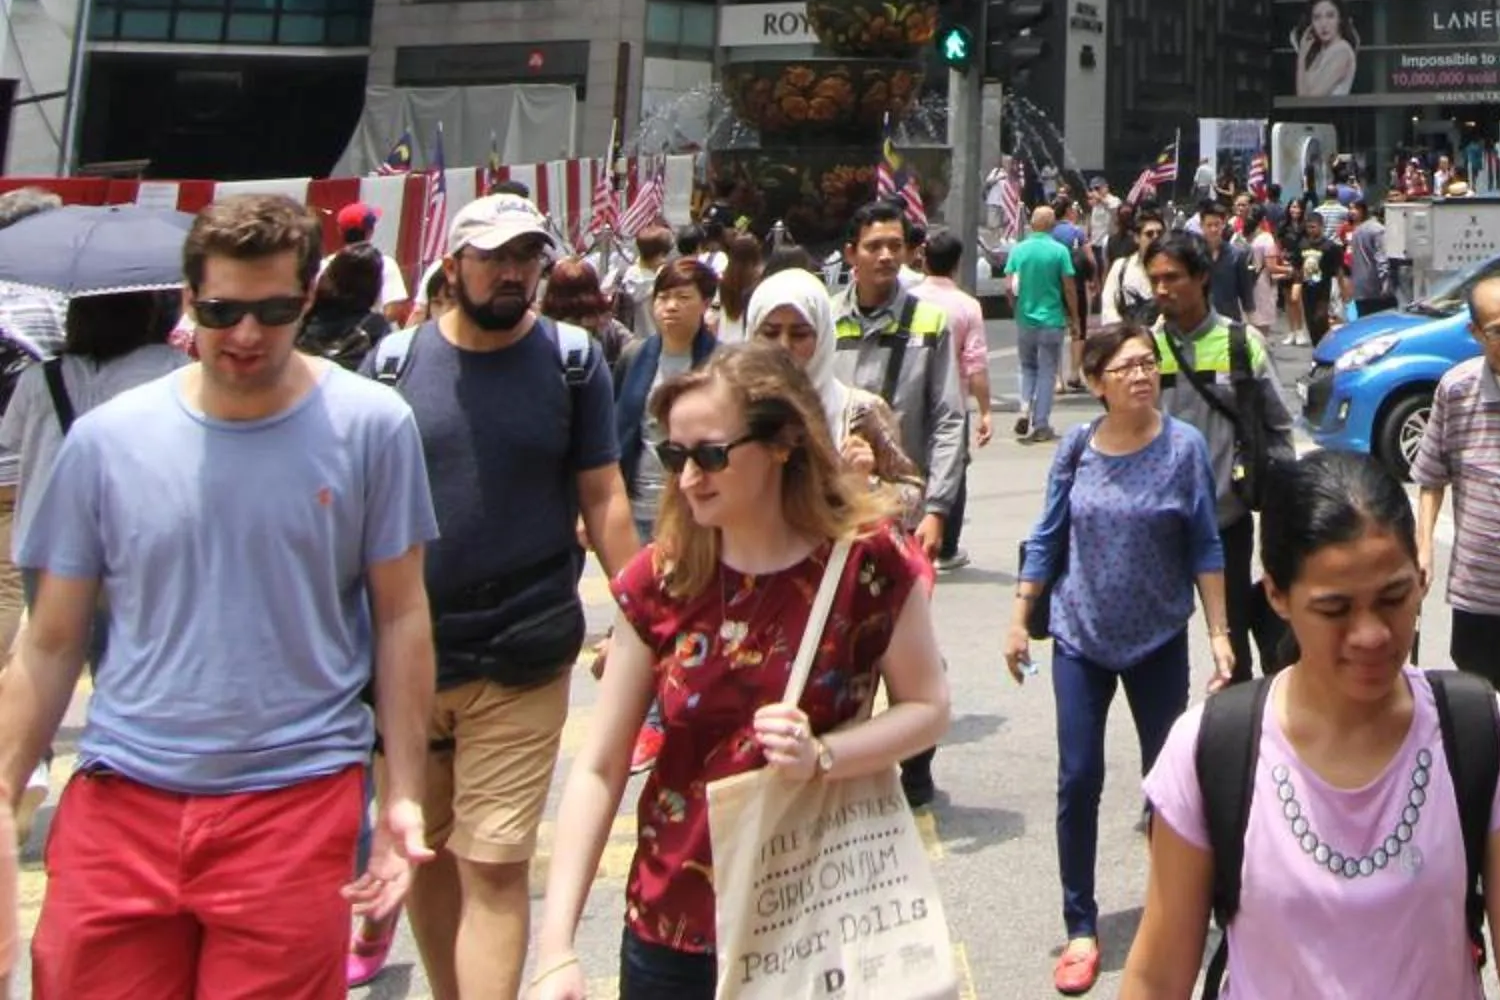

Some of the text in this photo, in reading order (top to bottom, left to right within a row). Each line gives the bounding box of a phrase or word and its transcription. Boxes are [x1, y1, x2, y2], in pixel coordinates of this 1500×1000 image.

[1401, 53, 1478, 69] Impossible
[1481, 53, 1495, 66] to
[1391, 71, 1466, 87] 10,000,000
[819, 856, 856, 890] ON
[738, 929, 831, 984] Paper
[839, 897, 929, 945] Dolls
